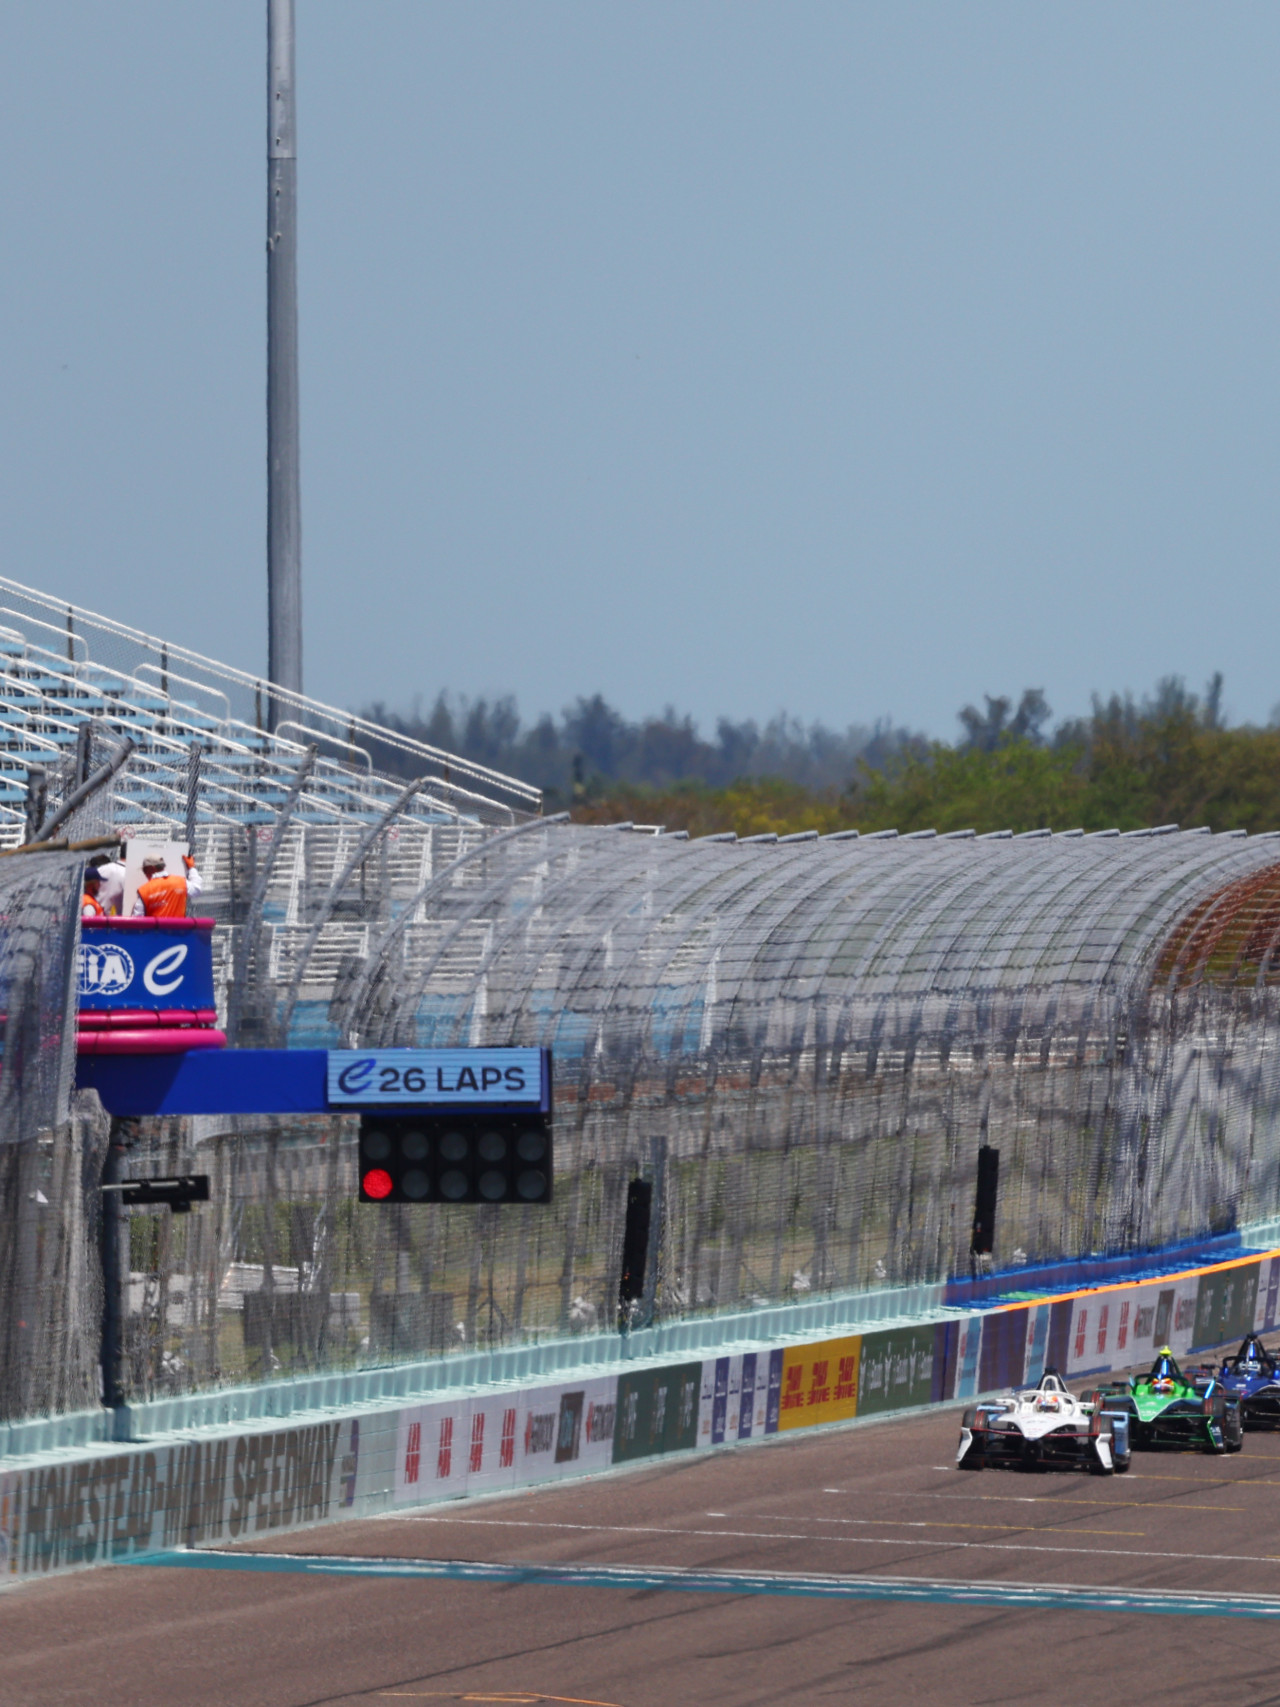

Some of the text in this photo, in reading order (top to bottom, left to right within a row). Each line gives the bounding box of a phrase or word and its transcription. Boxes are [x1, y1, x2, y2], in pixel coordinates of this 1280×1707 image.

[379, 1067, 426, 1092] 26
[437, 1067, 526, 1092] LAPS
[22, 1439, 229, 1573] HOMESTEAD-MIAMI
[229, 1423, 341, 1538] SPEEDWAY
